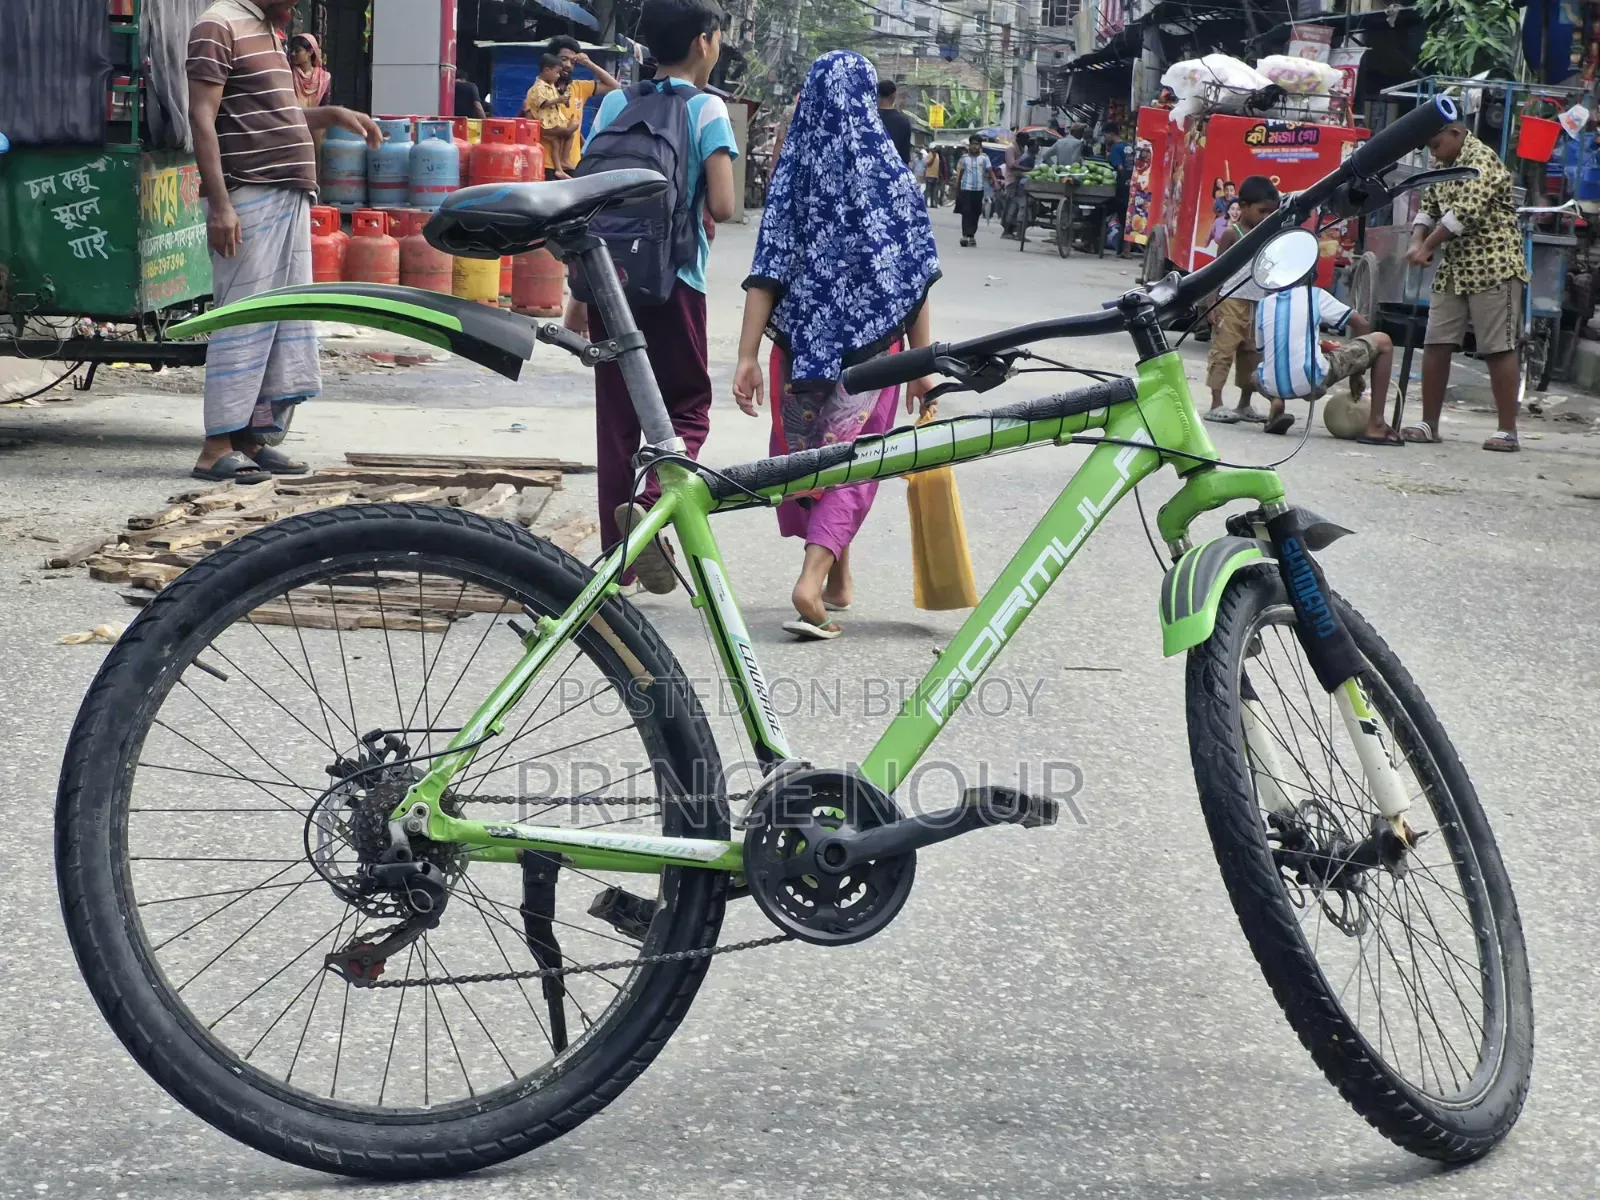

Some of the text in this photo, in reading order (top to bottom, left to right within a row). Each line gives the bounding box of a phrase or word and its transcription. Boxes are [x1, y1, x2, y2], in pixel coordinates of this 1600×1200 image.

[1246, 125, 1317, 144] কী মজা গো
[24, 166, 100, 199] চল বন্ধু
[51, 196, 100, 230] স্কুলে
[67, 225, 109, 260] যাই
[1281, 537, 1337, 639] SHIMANO
[738, 642, 784, 740] COURAGE
